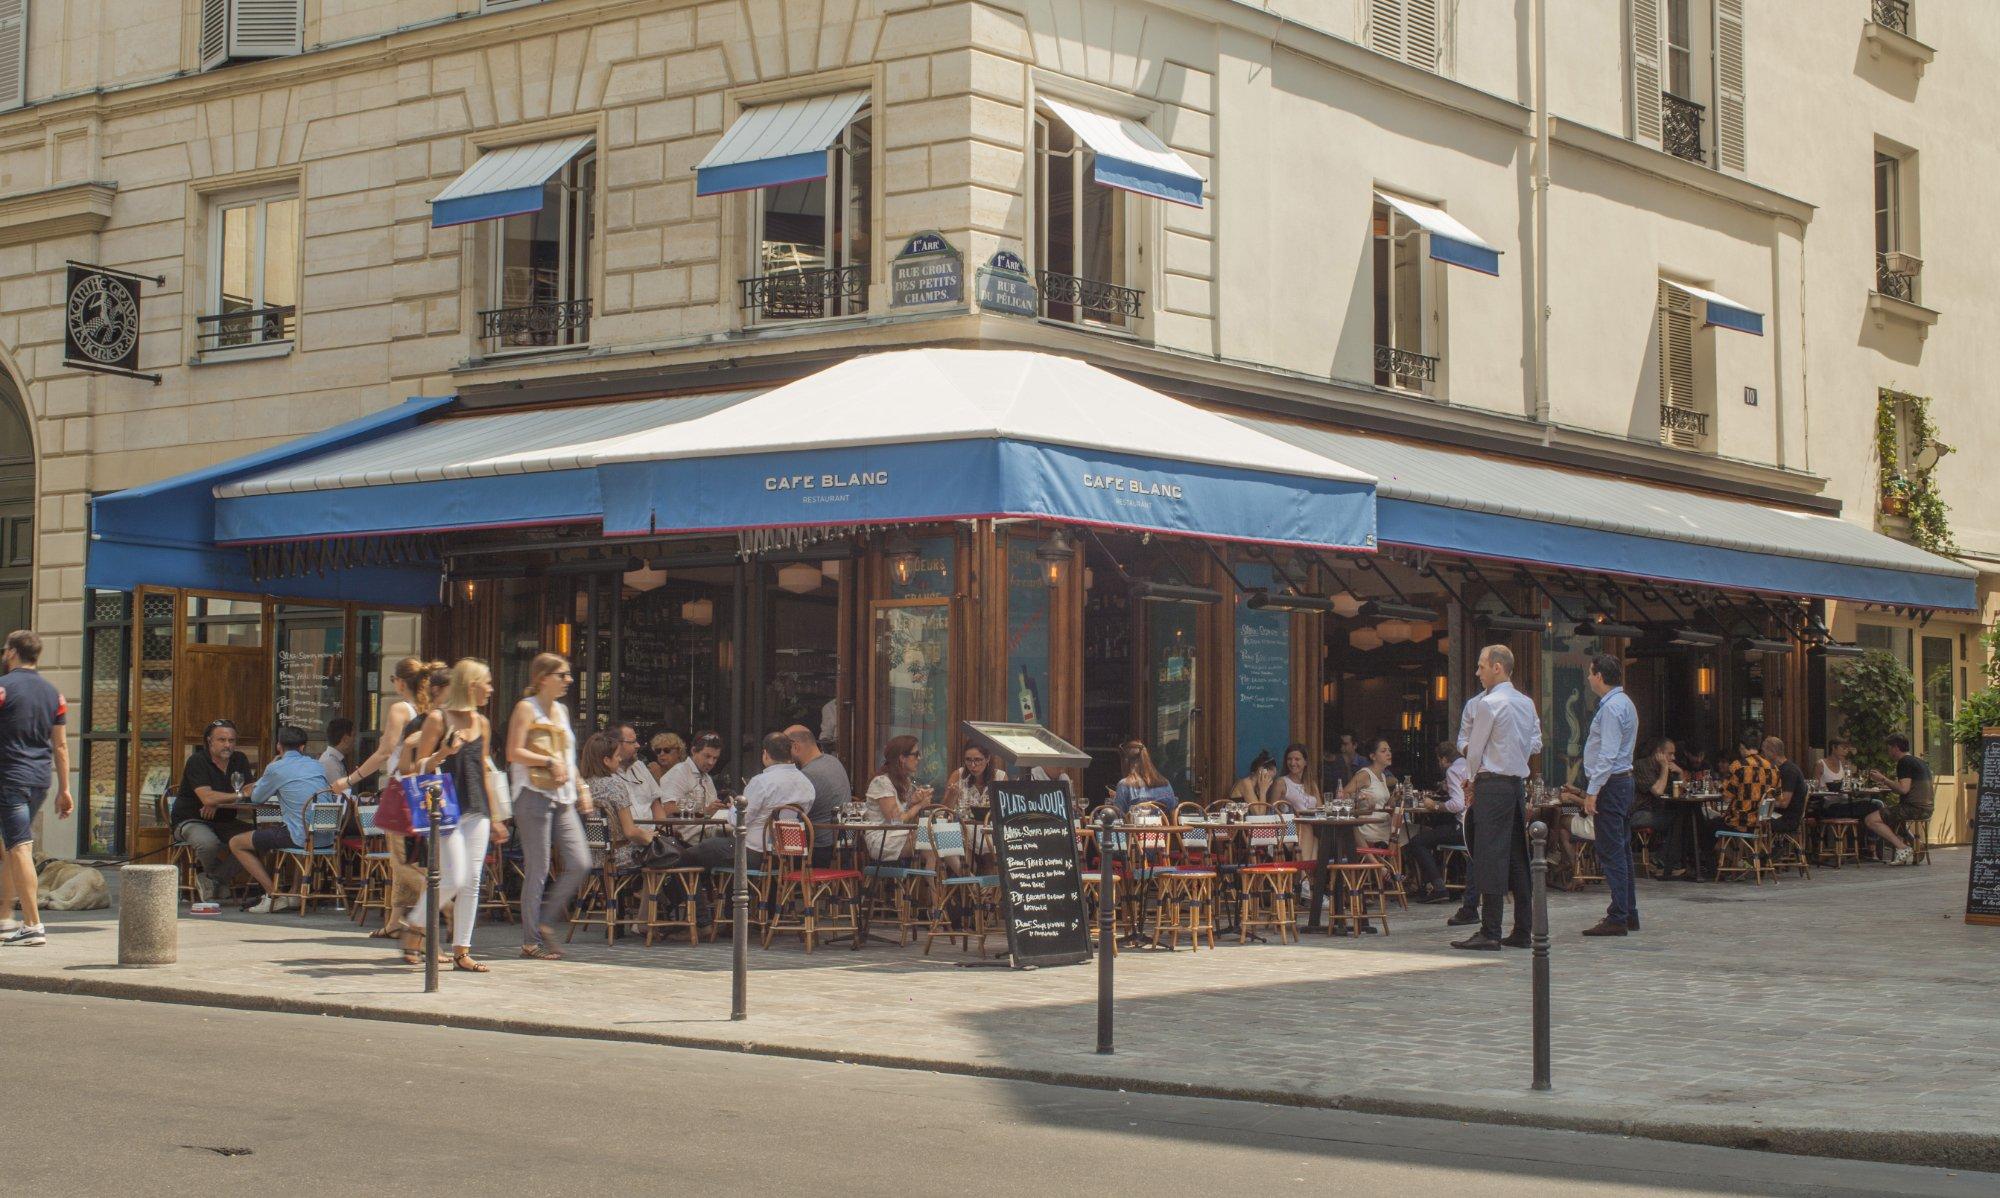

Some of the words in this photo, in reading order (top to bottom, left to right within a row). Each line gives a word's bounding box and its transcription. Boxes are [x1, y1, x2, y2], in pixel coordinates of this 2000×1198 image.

[898, 267, 919, 279] RUE
[922, 262, 953, 276] CROIX
[895, 280, 916, 291] DES
[919, 275, 957, 290] PETITS
[997, 280, 1016, 294] RUE
[981, 290, 993, 301] DU
[996, 292, 1033, 311] PÉLICAN
[1746, 389, 1755, 404] 10
[765, 475, 815, 490] CAFE
[821, 471, 888, 488] BLANC
[1083, 473, 1125, 491] CAFE
[1129, 479, 1182, 499] BLANC
[802, 494, 850, 504] RESTAURANT
[998, 790, 1027, 818] PLATS
[1038, 790, 1068, 820] JOUR
